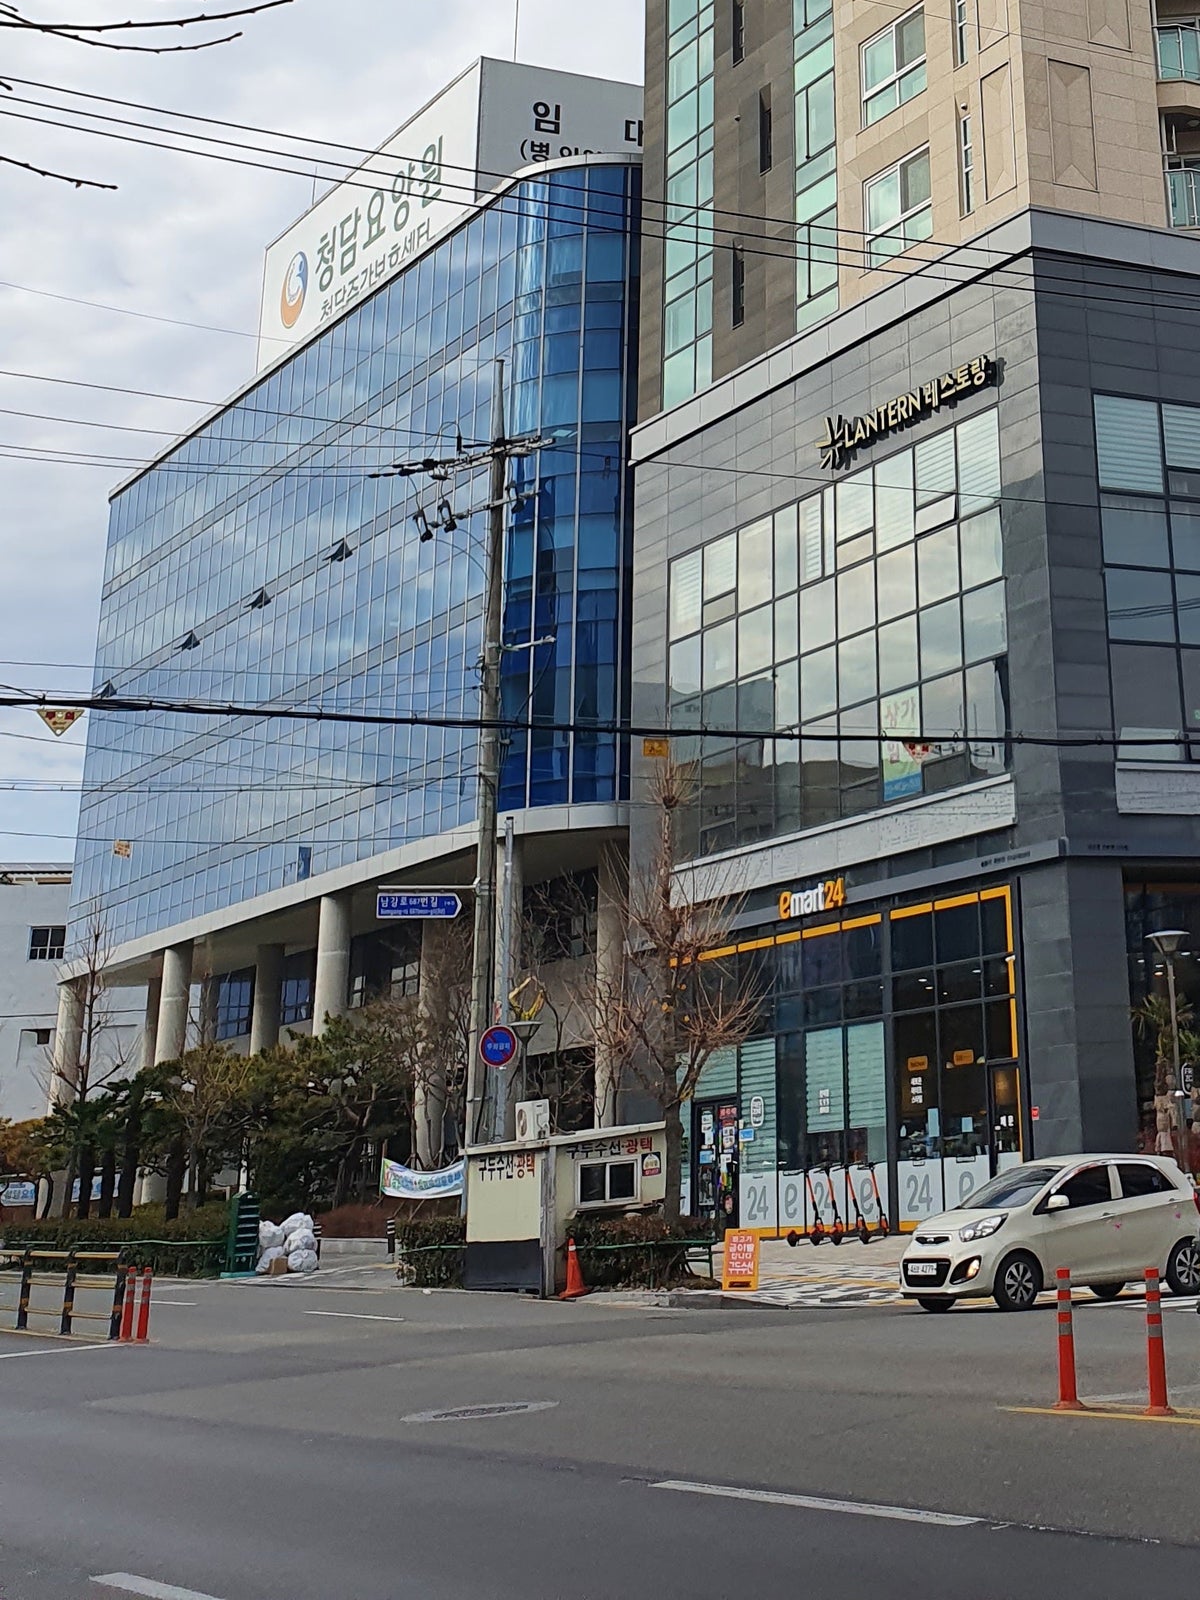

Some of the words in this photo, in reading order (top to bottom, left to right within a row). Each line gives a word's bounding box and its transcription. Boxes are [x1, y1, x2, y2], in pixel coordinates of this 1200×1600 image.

[315, 135, 443, 292] 청담요양원
[845, 387, 921, 448] LANTERN
[923, 355, 987, 407] 레스토랑
[778, 877, 845, 919] emart24
